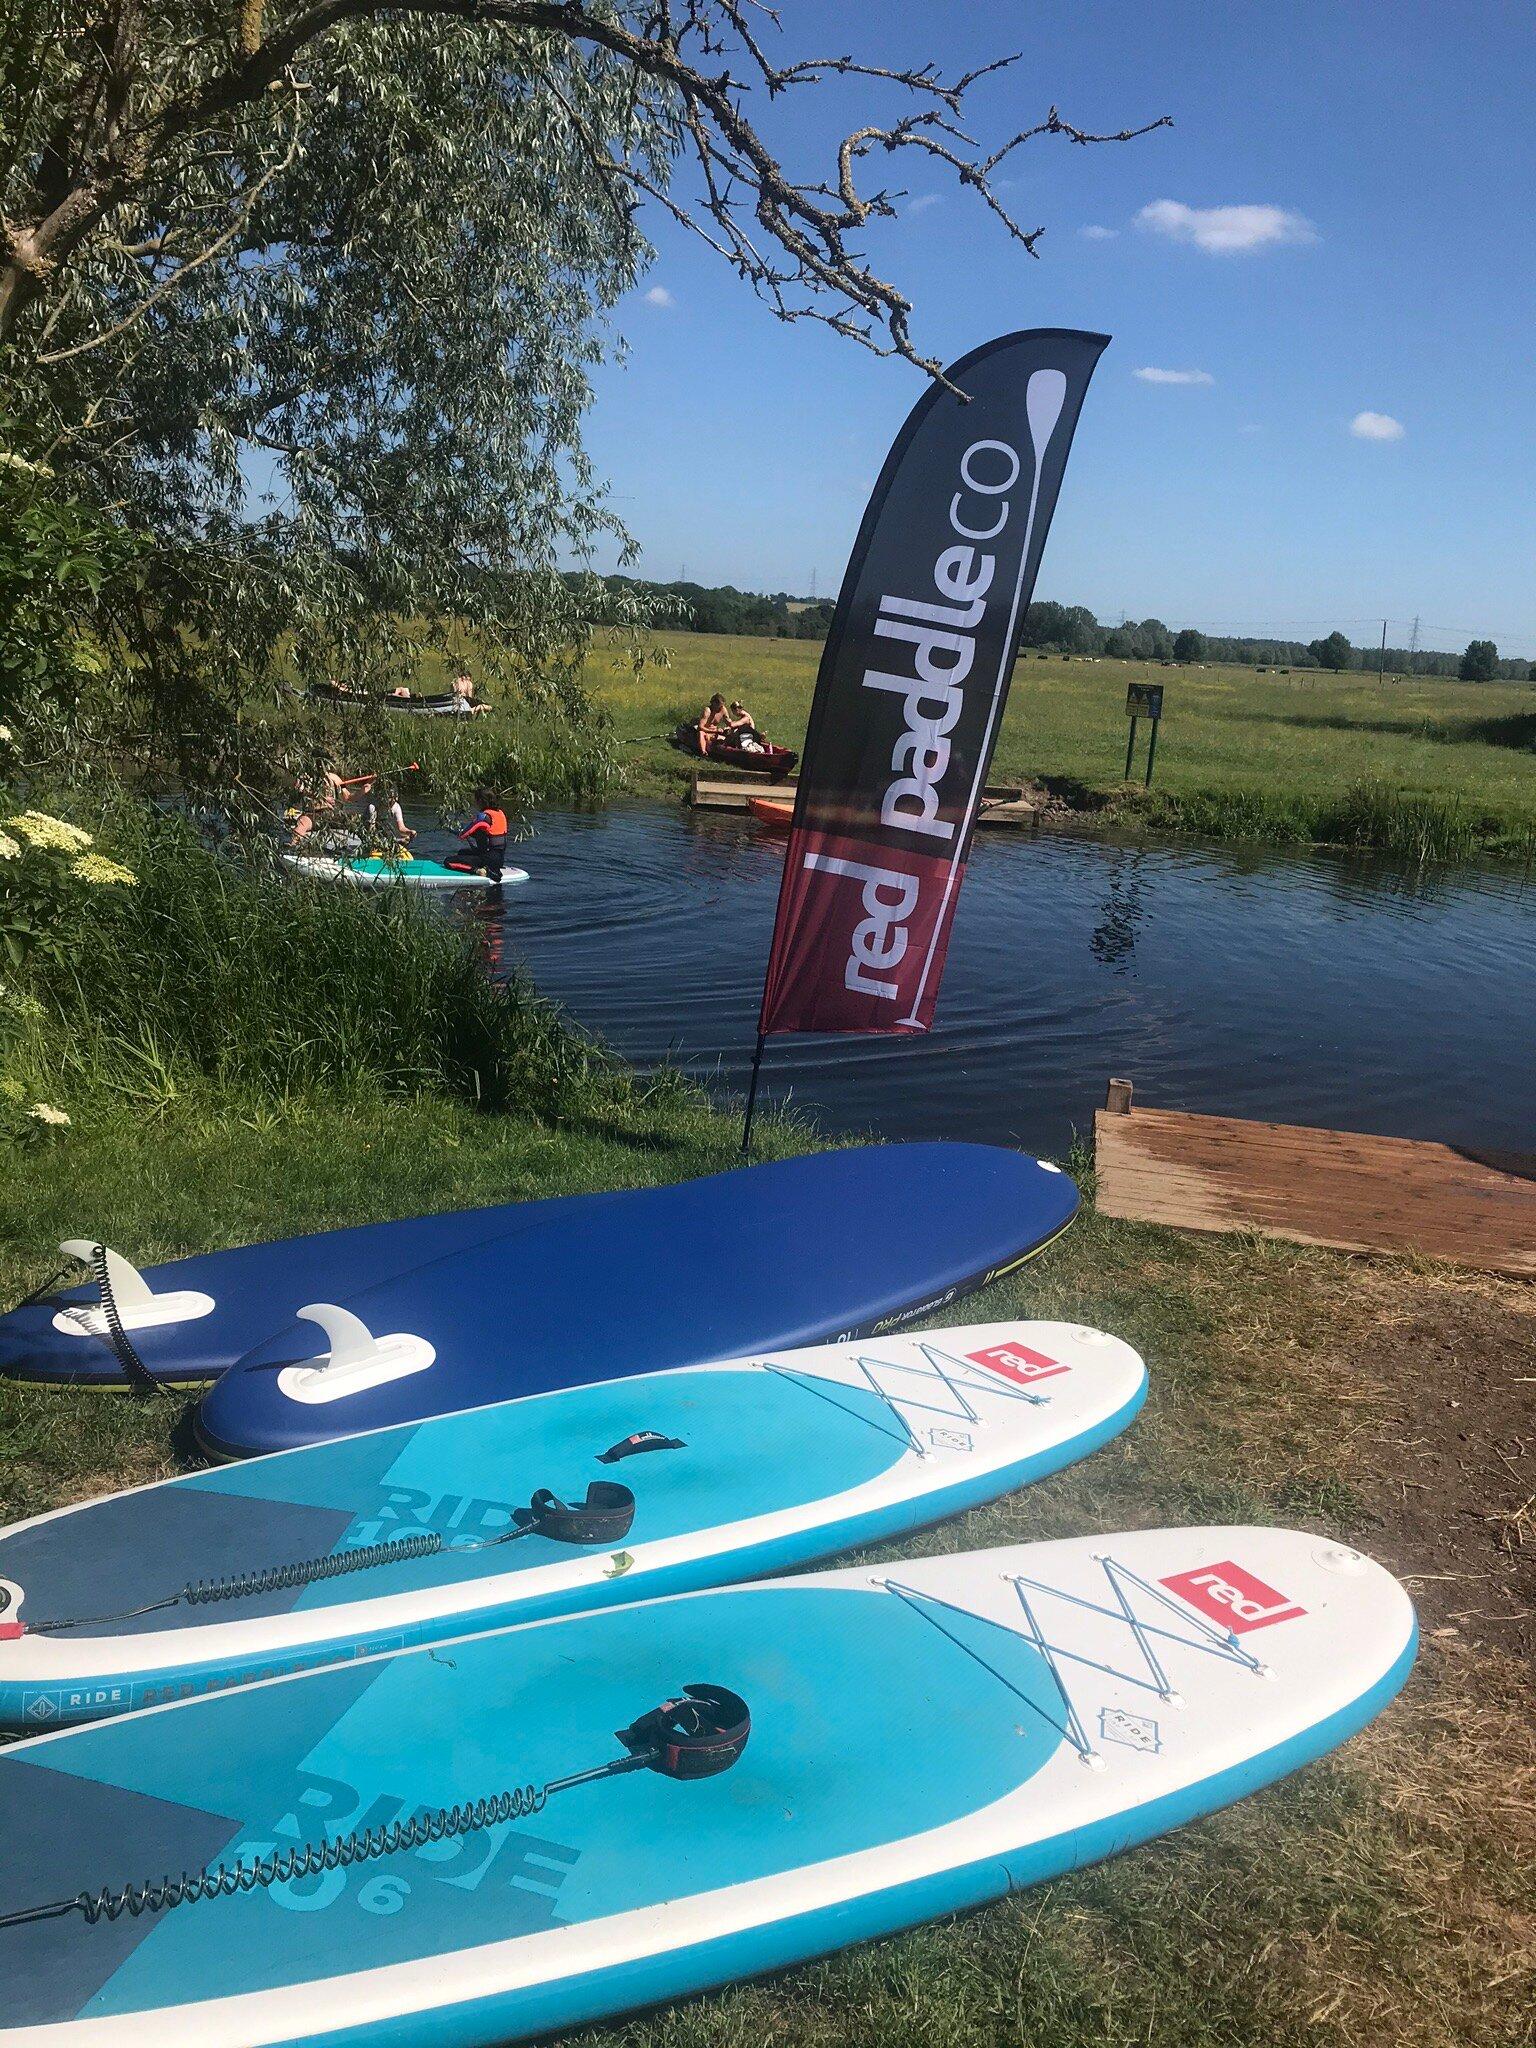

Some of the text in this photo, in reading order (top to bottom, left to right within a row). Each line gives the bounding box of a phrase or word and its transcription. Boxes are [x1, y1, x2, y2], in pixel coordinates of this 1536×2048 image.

[804, 852, 919, 1001] red
[871, 1313, 903, 1334] PRO
[986, 1349, 1066, 1377] red
[1189, 1573, 1301, 1622] red
[70, 1689, 122, 1706] RIDE
[1114, 1715, 1152, 1744] RIDE
